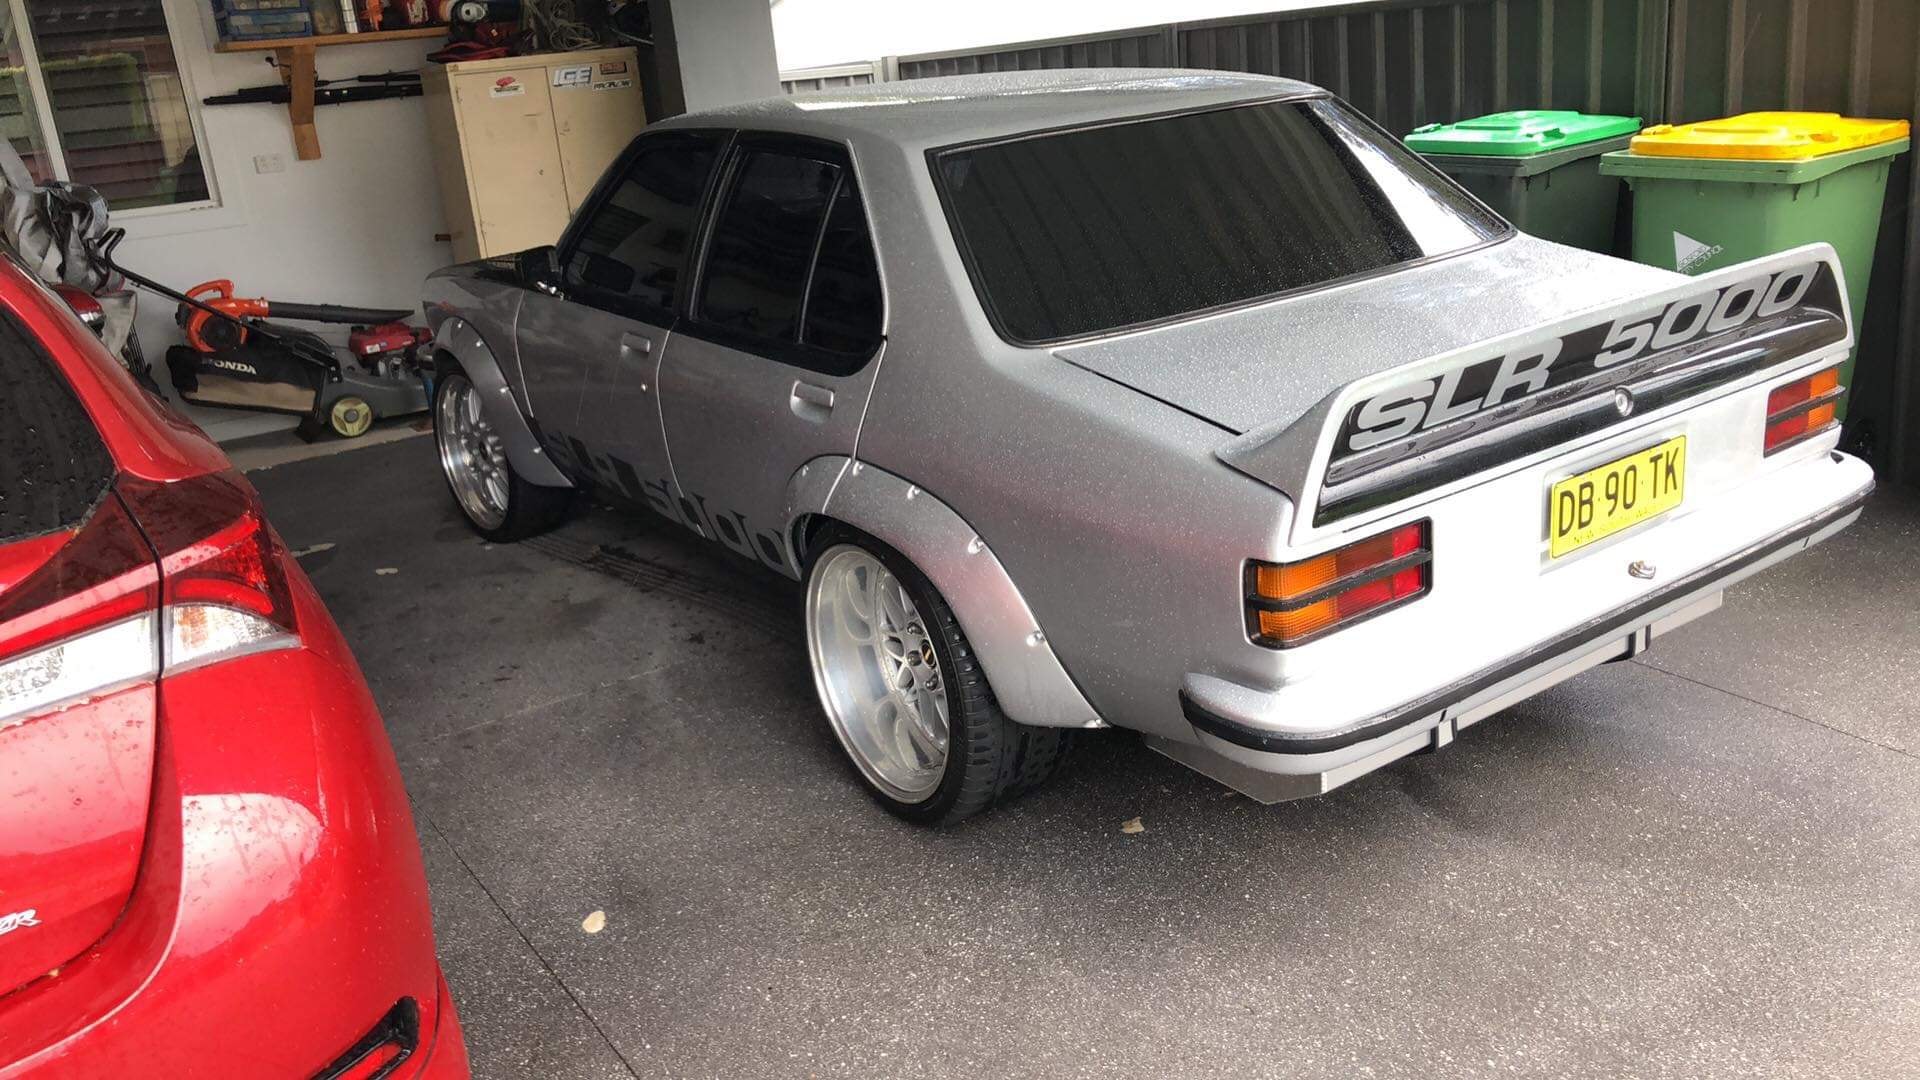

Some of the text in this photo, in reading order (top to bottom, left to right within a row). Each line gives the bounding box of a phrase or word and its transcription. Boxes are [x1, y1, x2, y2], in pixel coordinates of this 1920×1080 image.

[553, 66, 592, 87] ICE
[1349, 262, 1819, 450] SLR 5000
[1559, 447, 1679, 538] DB 90 TK
